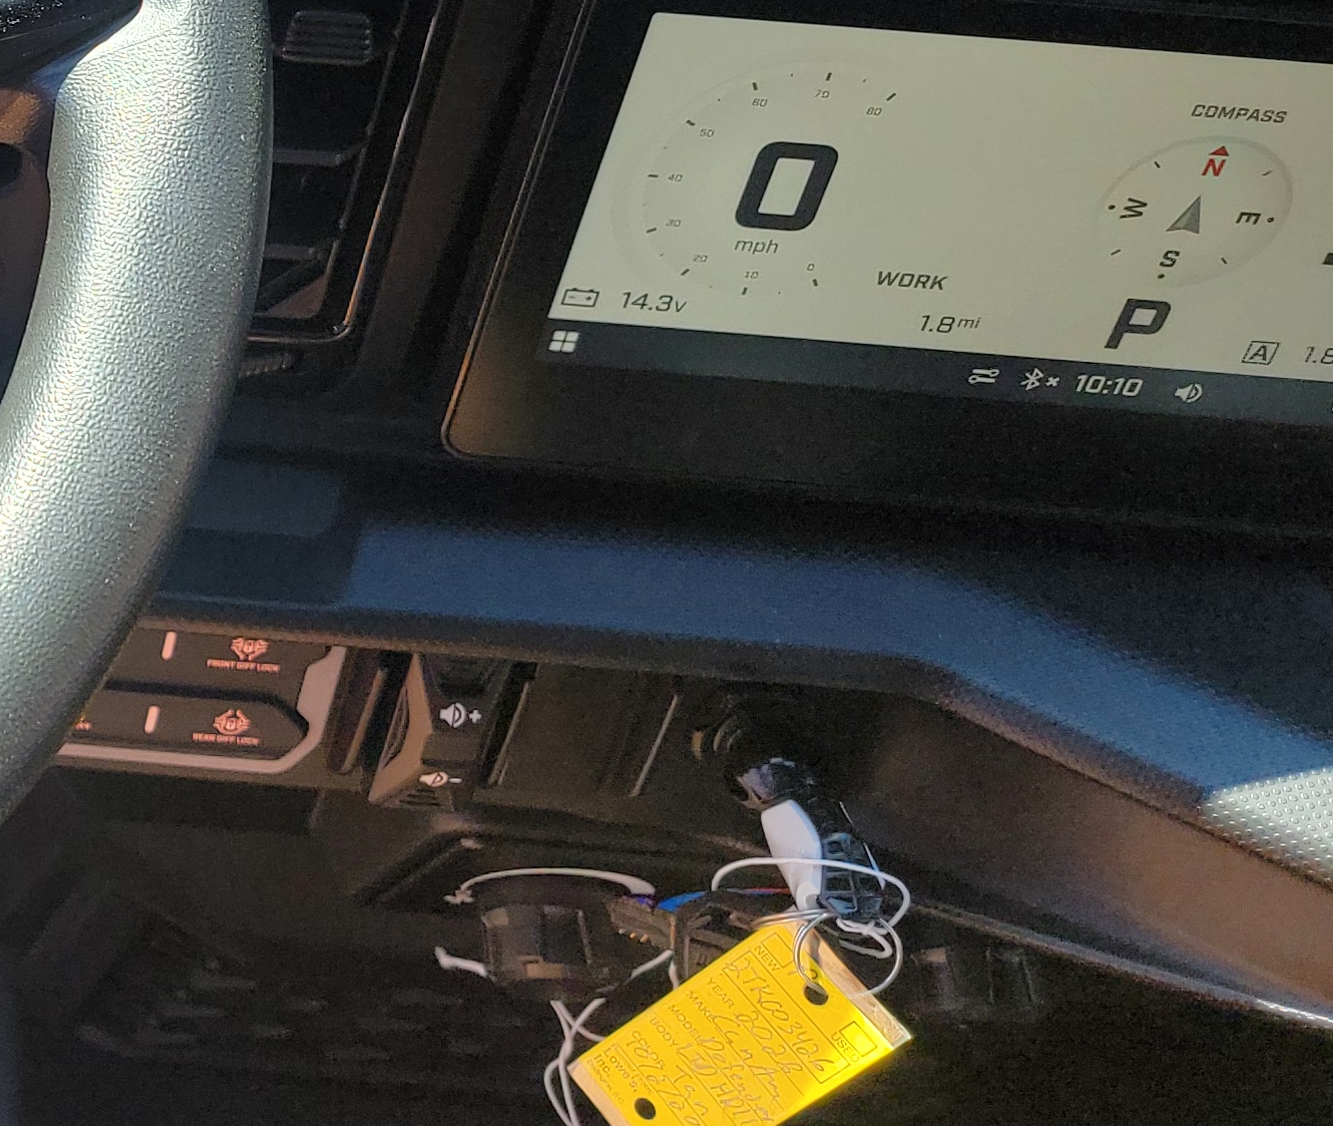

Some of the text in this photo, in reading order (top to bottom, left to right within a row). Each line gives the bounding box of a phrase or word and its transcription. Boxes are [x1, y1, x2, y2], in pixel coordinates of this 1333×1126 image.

[814, 89, 830, 99] 70
[1190, 104, 1287, 124] COMPASS
[699, 127, 715, 138] 50
[1201, 158, 1226, 177] N
[667, 173, 683, 183] 40
[735, 141, 838, 231] 0
[1119, 197, 1148, 220] W
[1235, 211, 1261, 225] E
[665, 218, 682, 229] 30
[734, 239, 779, 255] mph
[692, 254, 708, 263] 20
[1159, 250, 1180, 268] S
[744, 270, 759, 279] 10
[876, 271, 949, 292] WORK
[1104, 298, 1171, 349] P
[1075, 374, 1144, 397] 10:10
[206, 659, 281, 673] FRONT DIFF LOCK
[192, 732, 216, 743] REAR
[237, 735, 261, 747] LOCK
[753, 945, 781, 972] NEW
[707, 977, 736, 1008] YEAR
[686, 989, 716, 1023] MAKE
[650, 1017, 679, 1048] BODY
[668, 1004, 703, 1044] MODEL
[632, 1030, 666, 1071] COLOR
[831, 1031, 861, 1064] USED
